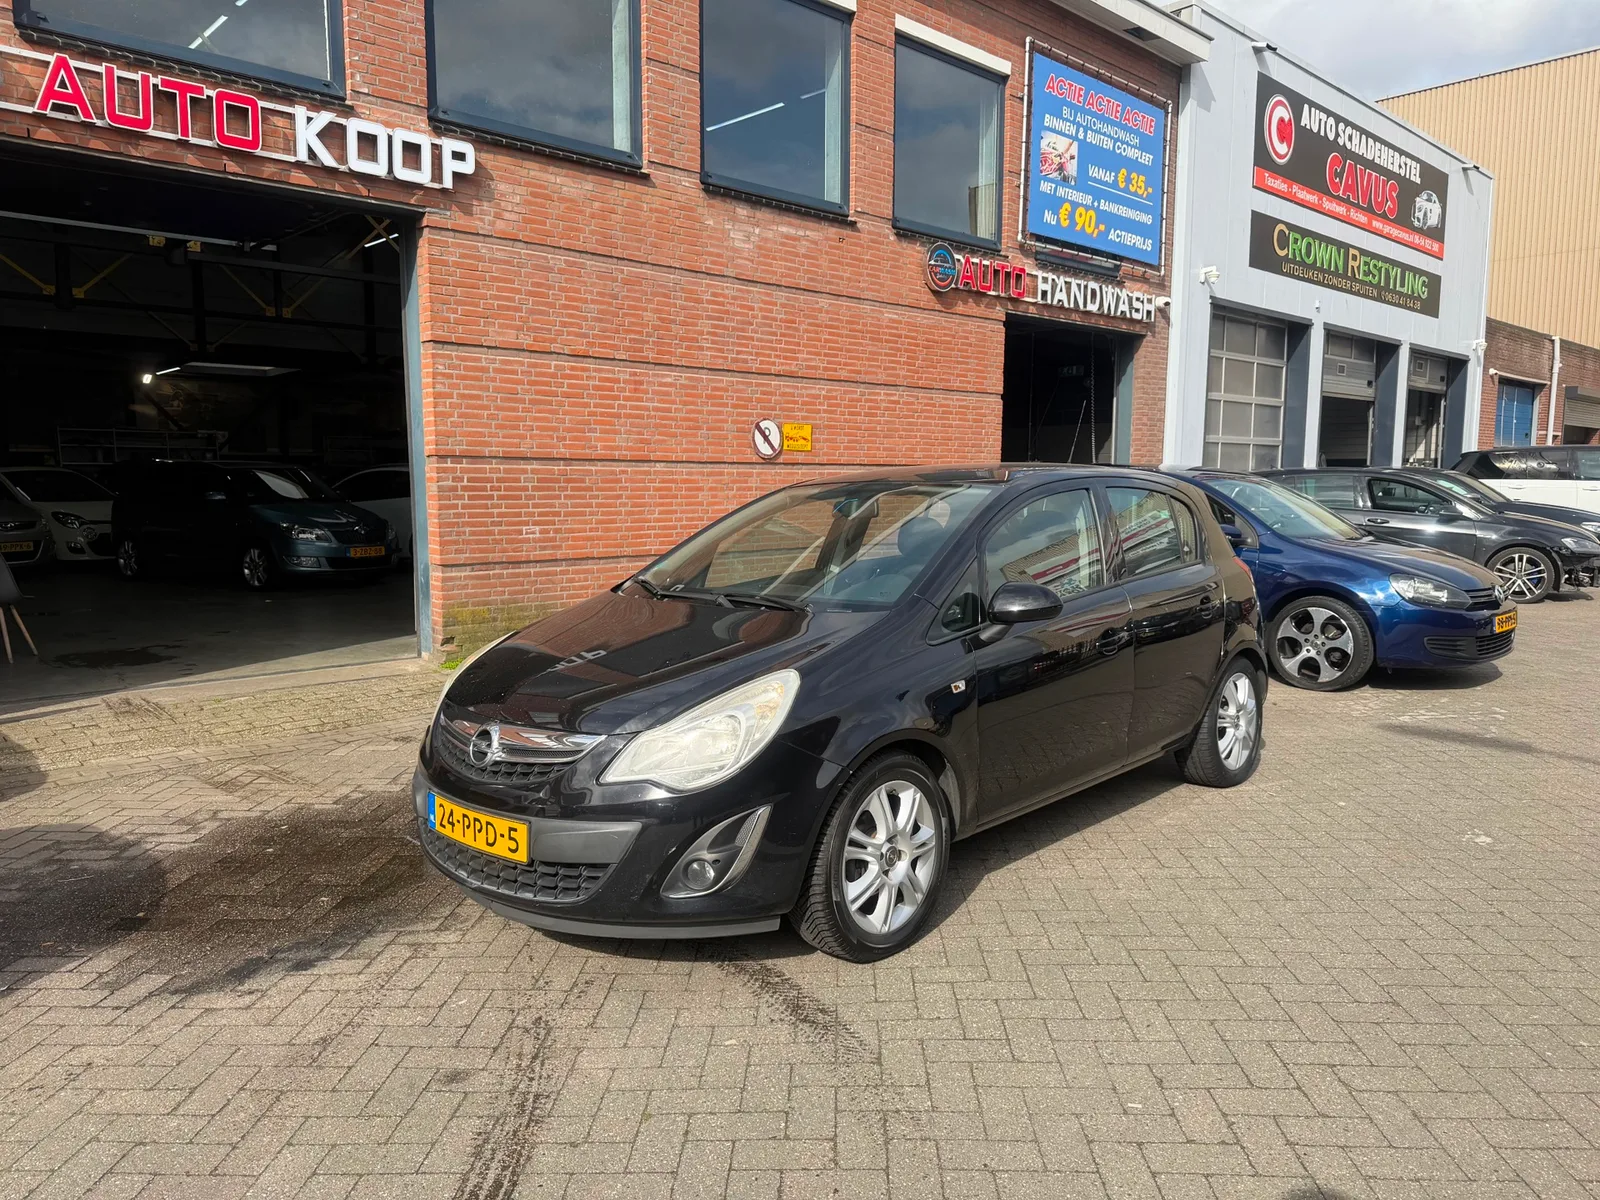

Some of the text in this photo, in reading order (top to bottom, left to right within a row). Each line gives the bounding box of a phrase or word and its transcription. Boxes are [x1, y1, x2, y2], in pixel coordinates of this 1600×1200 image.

[34, 53, 476, 190] AUTO KOOP
[1045, 73, 1156, 136] ACTIE ACTIE ACTIE
[1062, 106, 1140, 147] BIJ AUTOHANDWASH
[1044, 114, 1154, 167] BINNEN & BUITEN COMPLEET
[1300, 103, 1421, 185] AUTO SCHADEHERSTEL
[1040, 180, 1056, 195] MET
[1056, 185, 1093, 207] INTERIEUR
[1100, 199, 1153, 225] BANKREINIGING
[1088, 164, 1115, 184] VANAF
[1117, 168, 1127, 189] €
[1264, 173, 1288, 192] Taxaties
[1326, 152, 1399, 219] CAVUS
[1059, 202, 1072, 227] €
[1108, 228, 1153, 251] ACTIEPRIJS
[1273, 223, 1428, 300] CROWN RESTYLING
[1282, 261, 1323, 283] UITDEUKEN
[1323, 275, 1351, 291] ZONDER
[1352, 282, 1378, 298] SPUITEN
[959, 254, 1156, 322] AUTO HANDWASH
[438, 803, 520, 855] 24-PPD-5
